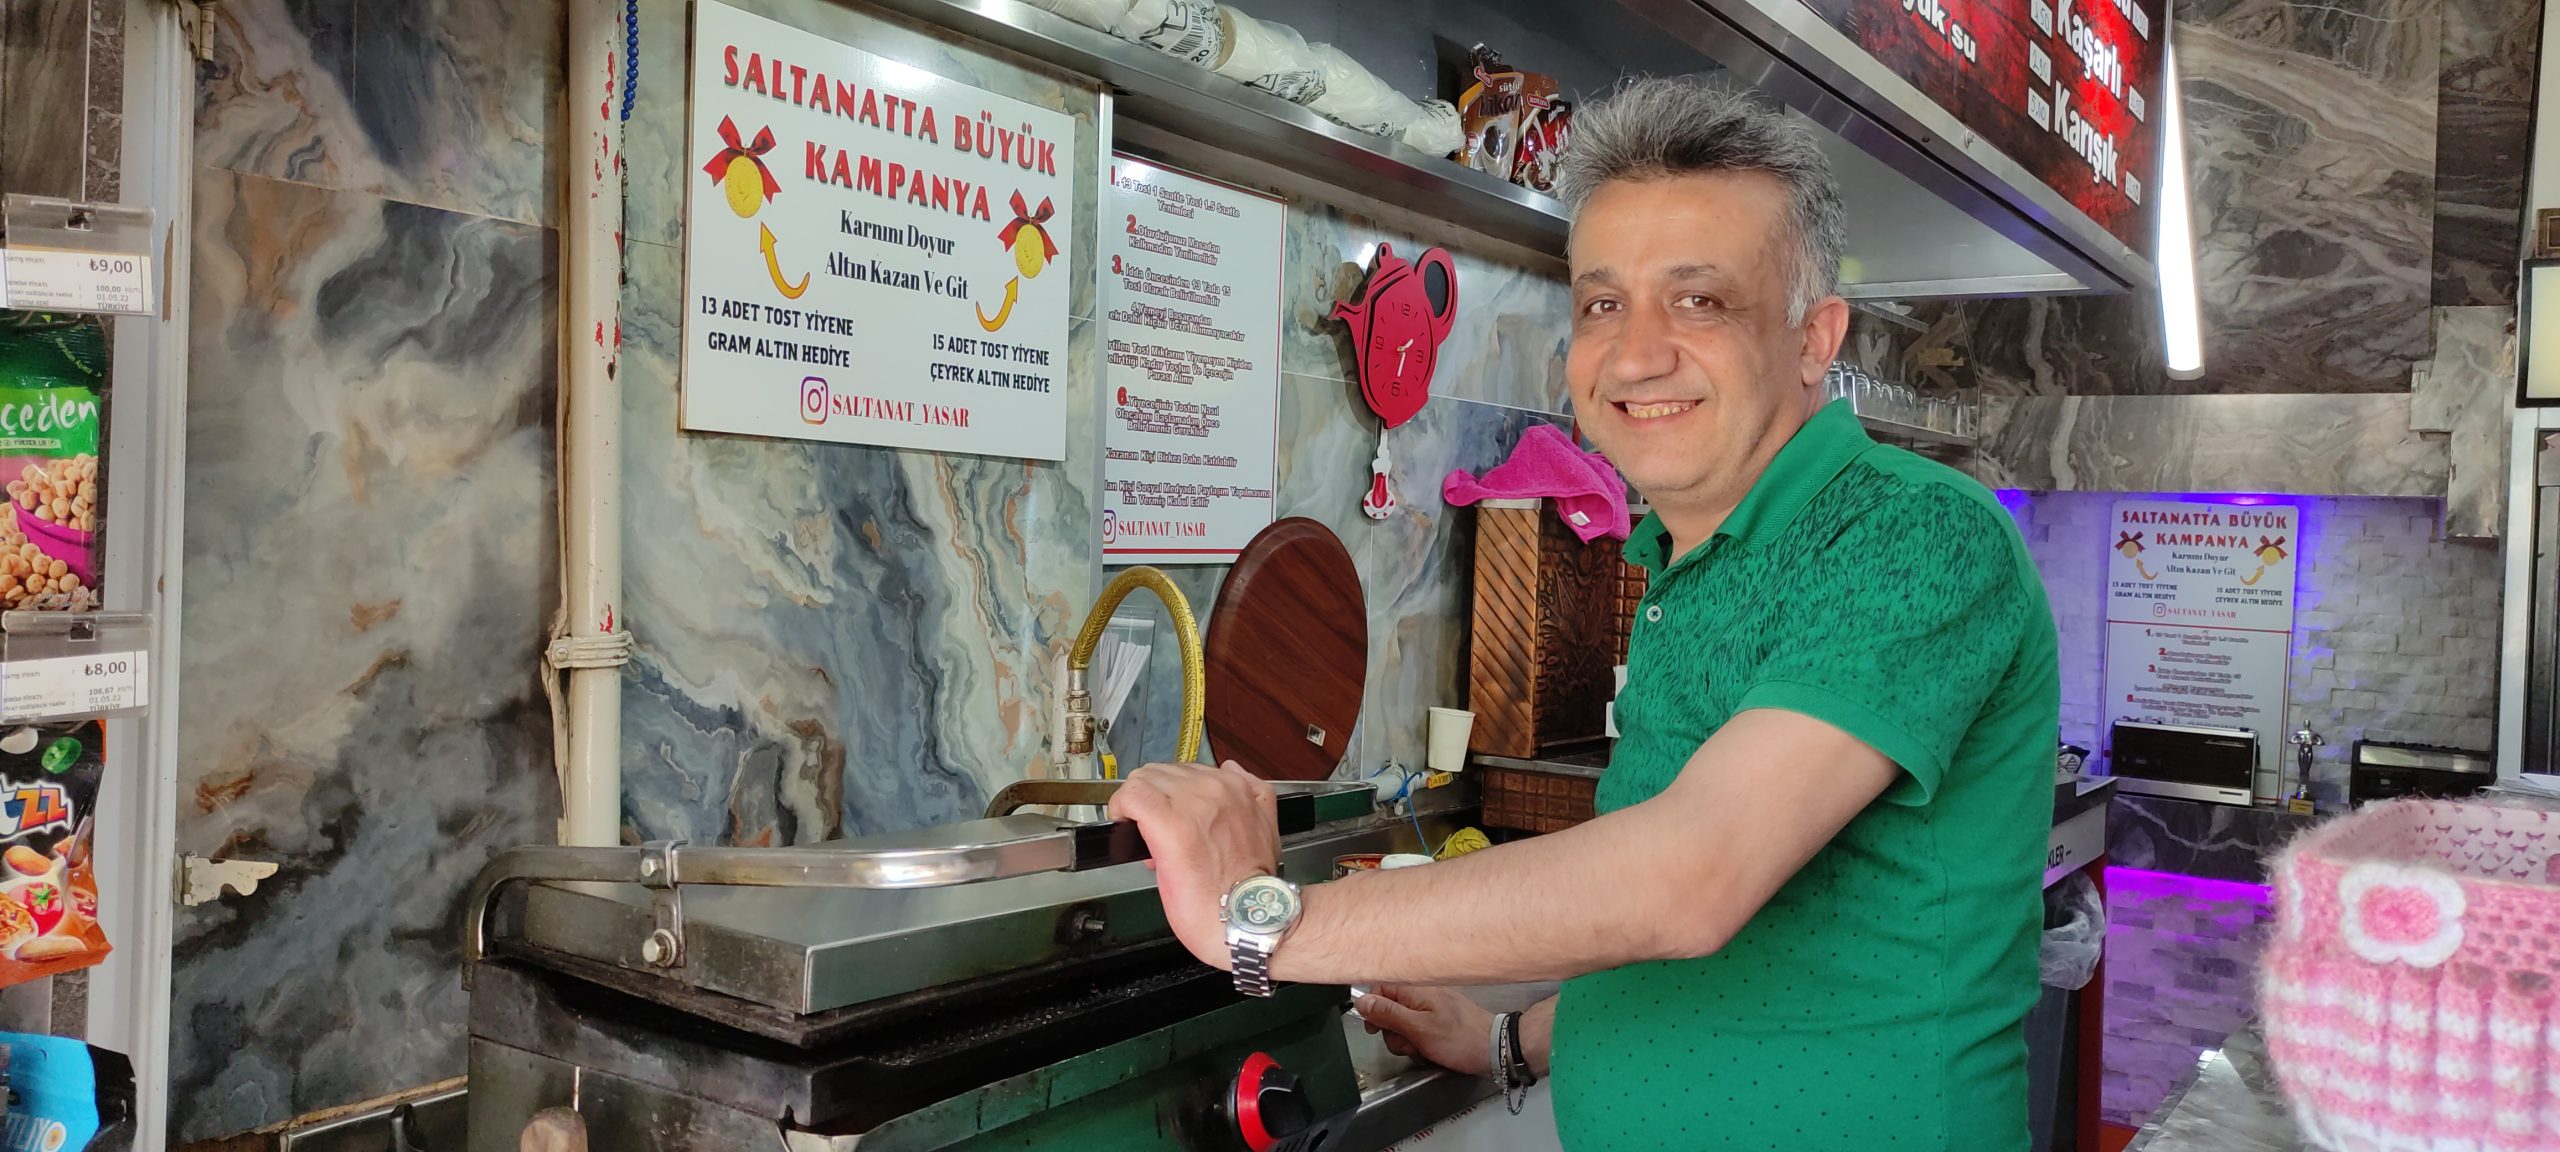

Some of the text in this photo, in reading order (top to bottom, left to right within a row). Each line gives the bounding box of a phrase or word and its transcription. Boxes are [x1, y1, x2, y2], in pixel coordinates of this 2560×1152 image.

[1951, 23, 1976, 63] su
[724, 44, 1056, 177] SALTANATTA BÜYÜK
[2054, 80, 2119, 189] Karışık
[804, 140, 992, 222] KAMPANYA
[1133, 180, 1151, 195] Tost
[1159, 187, 1185, 203] Saatte
[1186, 194, 1202, 209] Tost
[1204, 198, 1216, 211] 1.5
[1216, 203, 1240, 218] Saatte
[840, 209, 955, 259] Karnını Doyur
[1188, 237, 1221, 255] Masadan
[1129, 236, 1218, 266] Kalkmadan Yenilmelidir
[825, 251, 969, 301] Altın Kazan Ve Git
[1145, 267, 1190, 289] Öncesinden
[1192, 279, 1202, 290] 13
[1202, 281, 1220, 295] Yada
[1222, 285, 1231, 296] 15
[1123, 278, 1220, 307] Tost Olarak Belirtilmelidir
[701, 295, 854, 337] 13 ADET TOST YİYENE
[1122, 311, 1142, 325] Dahil
[1144, 314, 1168, 330] Hiçbir
[708, 332, 850, 369] GRAM ALTIN HEDİYE
[932, 333, 1050, 367] 15 ADET TOST YİYENE
[1132, 342, 1150, 355] Tost
[1186, 351, 1225, 367] Yiyemeyen
[1227, 357, 1252, 370] Kişiden
[930, 363, 1050, 394] ÇEYREK ALTIN HEDİYE
[1140, 356, 1163, 371] Kadar
[1165, 360, 1191, 375] Tostun
[1192, 363, 1202, 375] Ve
[1147, 368, 1172, 382] Parası
[832, 393, 970, 429] SALTANAT_YASAR
[1174, 401, 1200, 414] Tostun
[1201, 404, 1219, 416] Nasıl
[1201, 415, 1220, 428] Önce
[1127, 420, 1210, 437] Belirtmeniz Gereklidir
[1140, 450, 1156, 464] Kişi
[1157, 451, 1182, 464] Birkez
[1183, 453, 1202, 465] Daha
[1136, 481, 1161, 495] Sosyal
[1163, 483, 1197, 496] Medyada
[1198, 484, 1230, 498] Paylaşım
[1167, 495, 1190, 507] Kabul
[1190, 496, 1209, 507] Edilir
[1119, 520, 1206, 538] SALTANAT_YASAR
[2122, 510, 2287, 529] SALTANATTA BÜYÜK
[2156, 532, 2249, 549] KAMPANYA
[2186, 566, 2211, 574] Kazan
[2212, 566, 2223, 575] Ve
[2224, 567, 2236, 576] Git
[2204, 552, 2229, 564] Doyur
